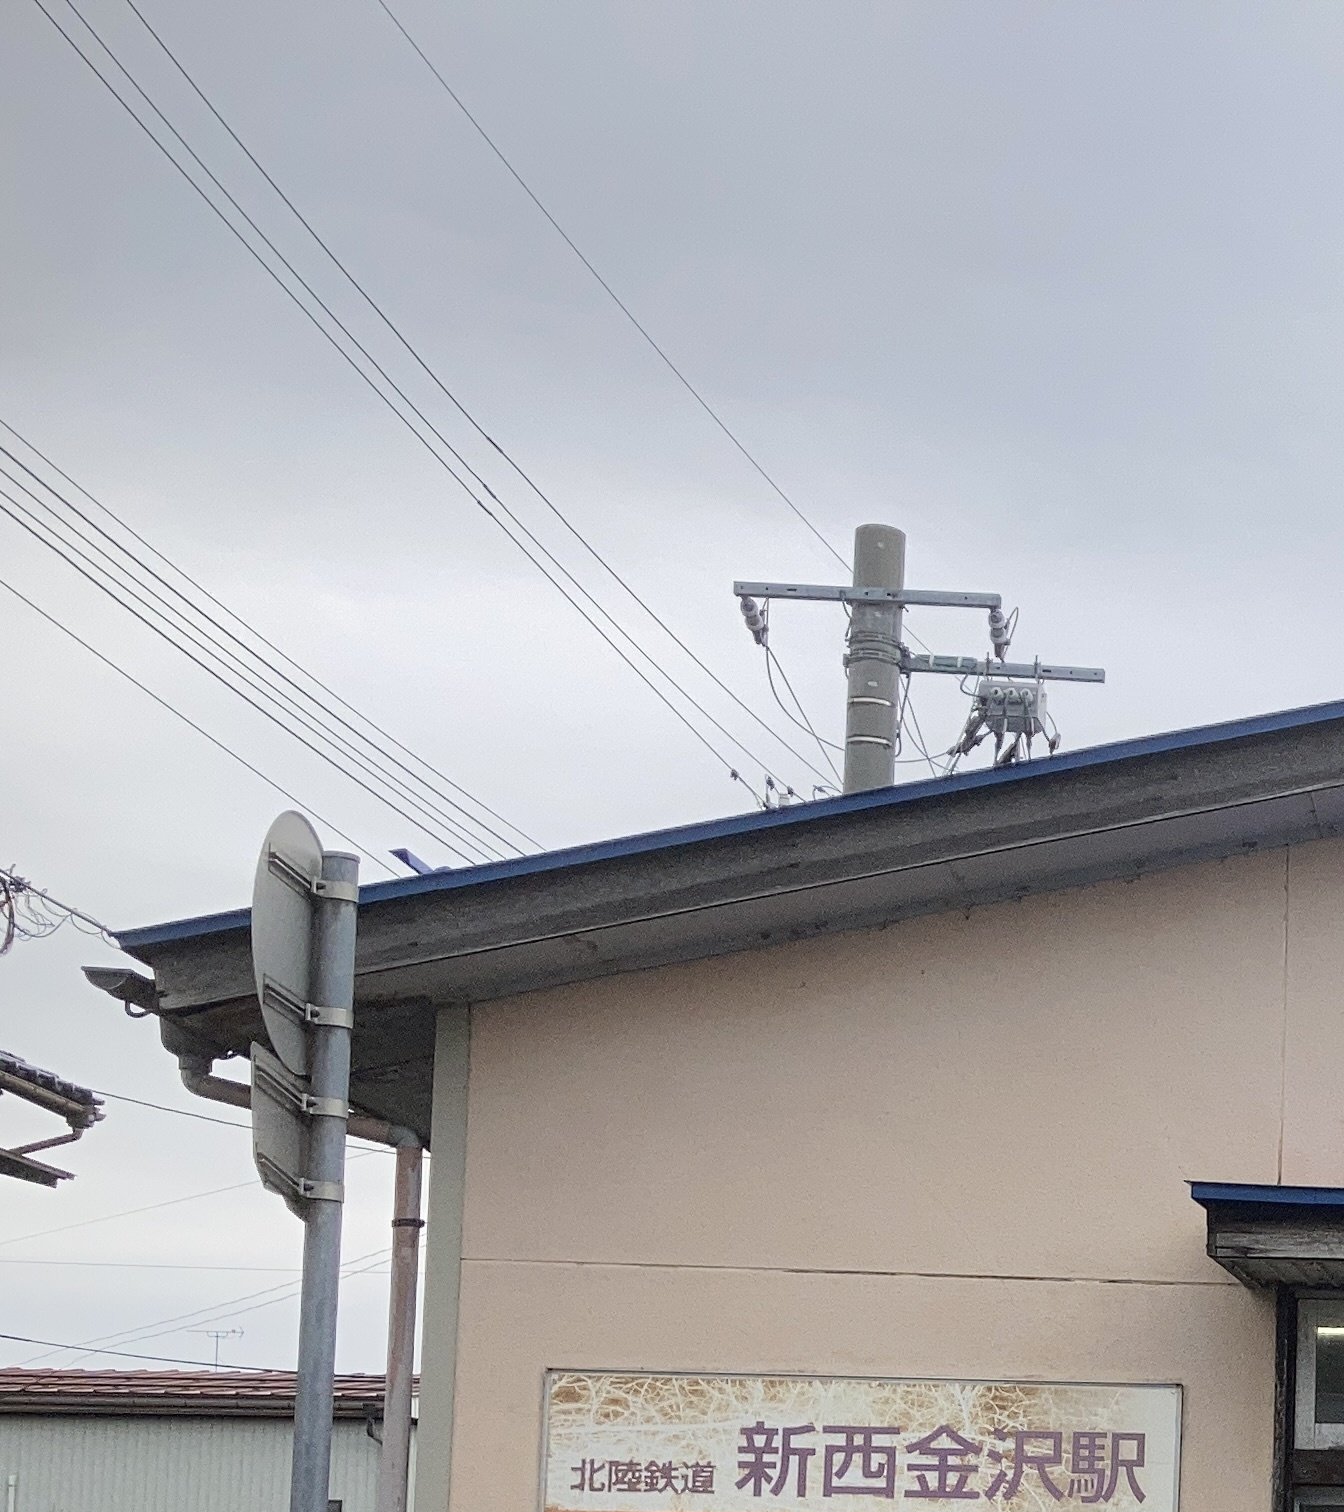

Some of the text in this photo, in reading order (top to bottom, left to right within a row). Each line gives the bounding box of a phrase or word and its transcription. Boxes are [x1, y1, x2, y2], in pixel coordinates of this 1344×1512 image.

[570, 1420, 1147, 1505] 北陸鉄道 新西金沢駅
